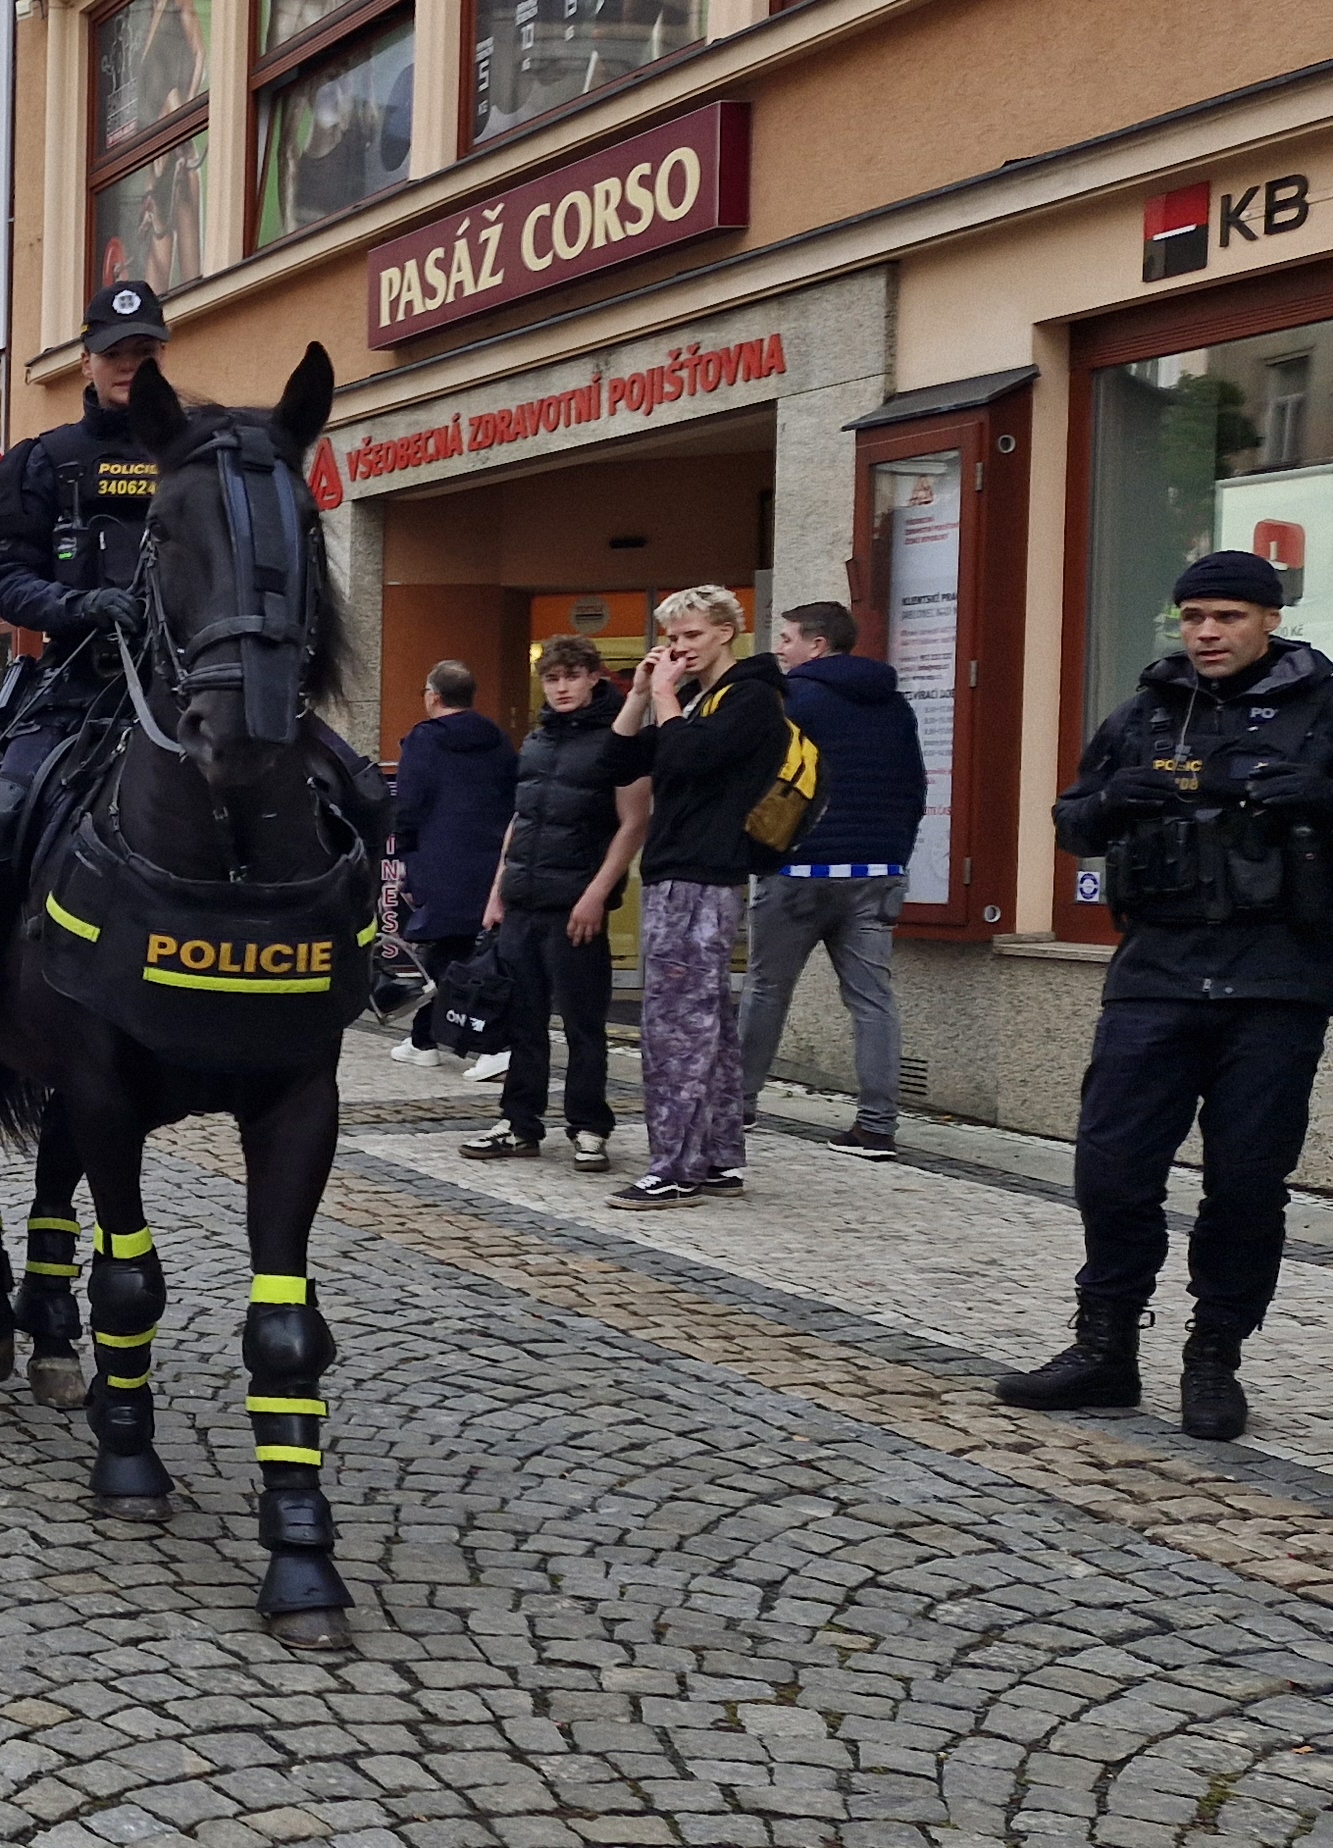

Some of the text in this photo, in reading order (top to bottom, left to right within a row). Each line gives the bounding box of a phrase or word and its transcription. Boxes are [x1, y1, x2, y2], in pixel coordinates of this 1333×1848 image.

[379, 146, 702, 329] PASÁŽ CORSO
[1219, 173, 1310, 248] KB
[346, 333, 787, 482] VŠEOBECNÁ ZDRAVOTNÍ POJIŠŤOVNA
[98, 463, 159, 475] POLICIE
[98, 480, 157, 495] 340624
[146, 933, 333, 974] POLICIE
